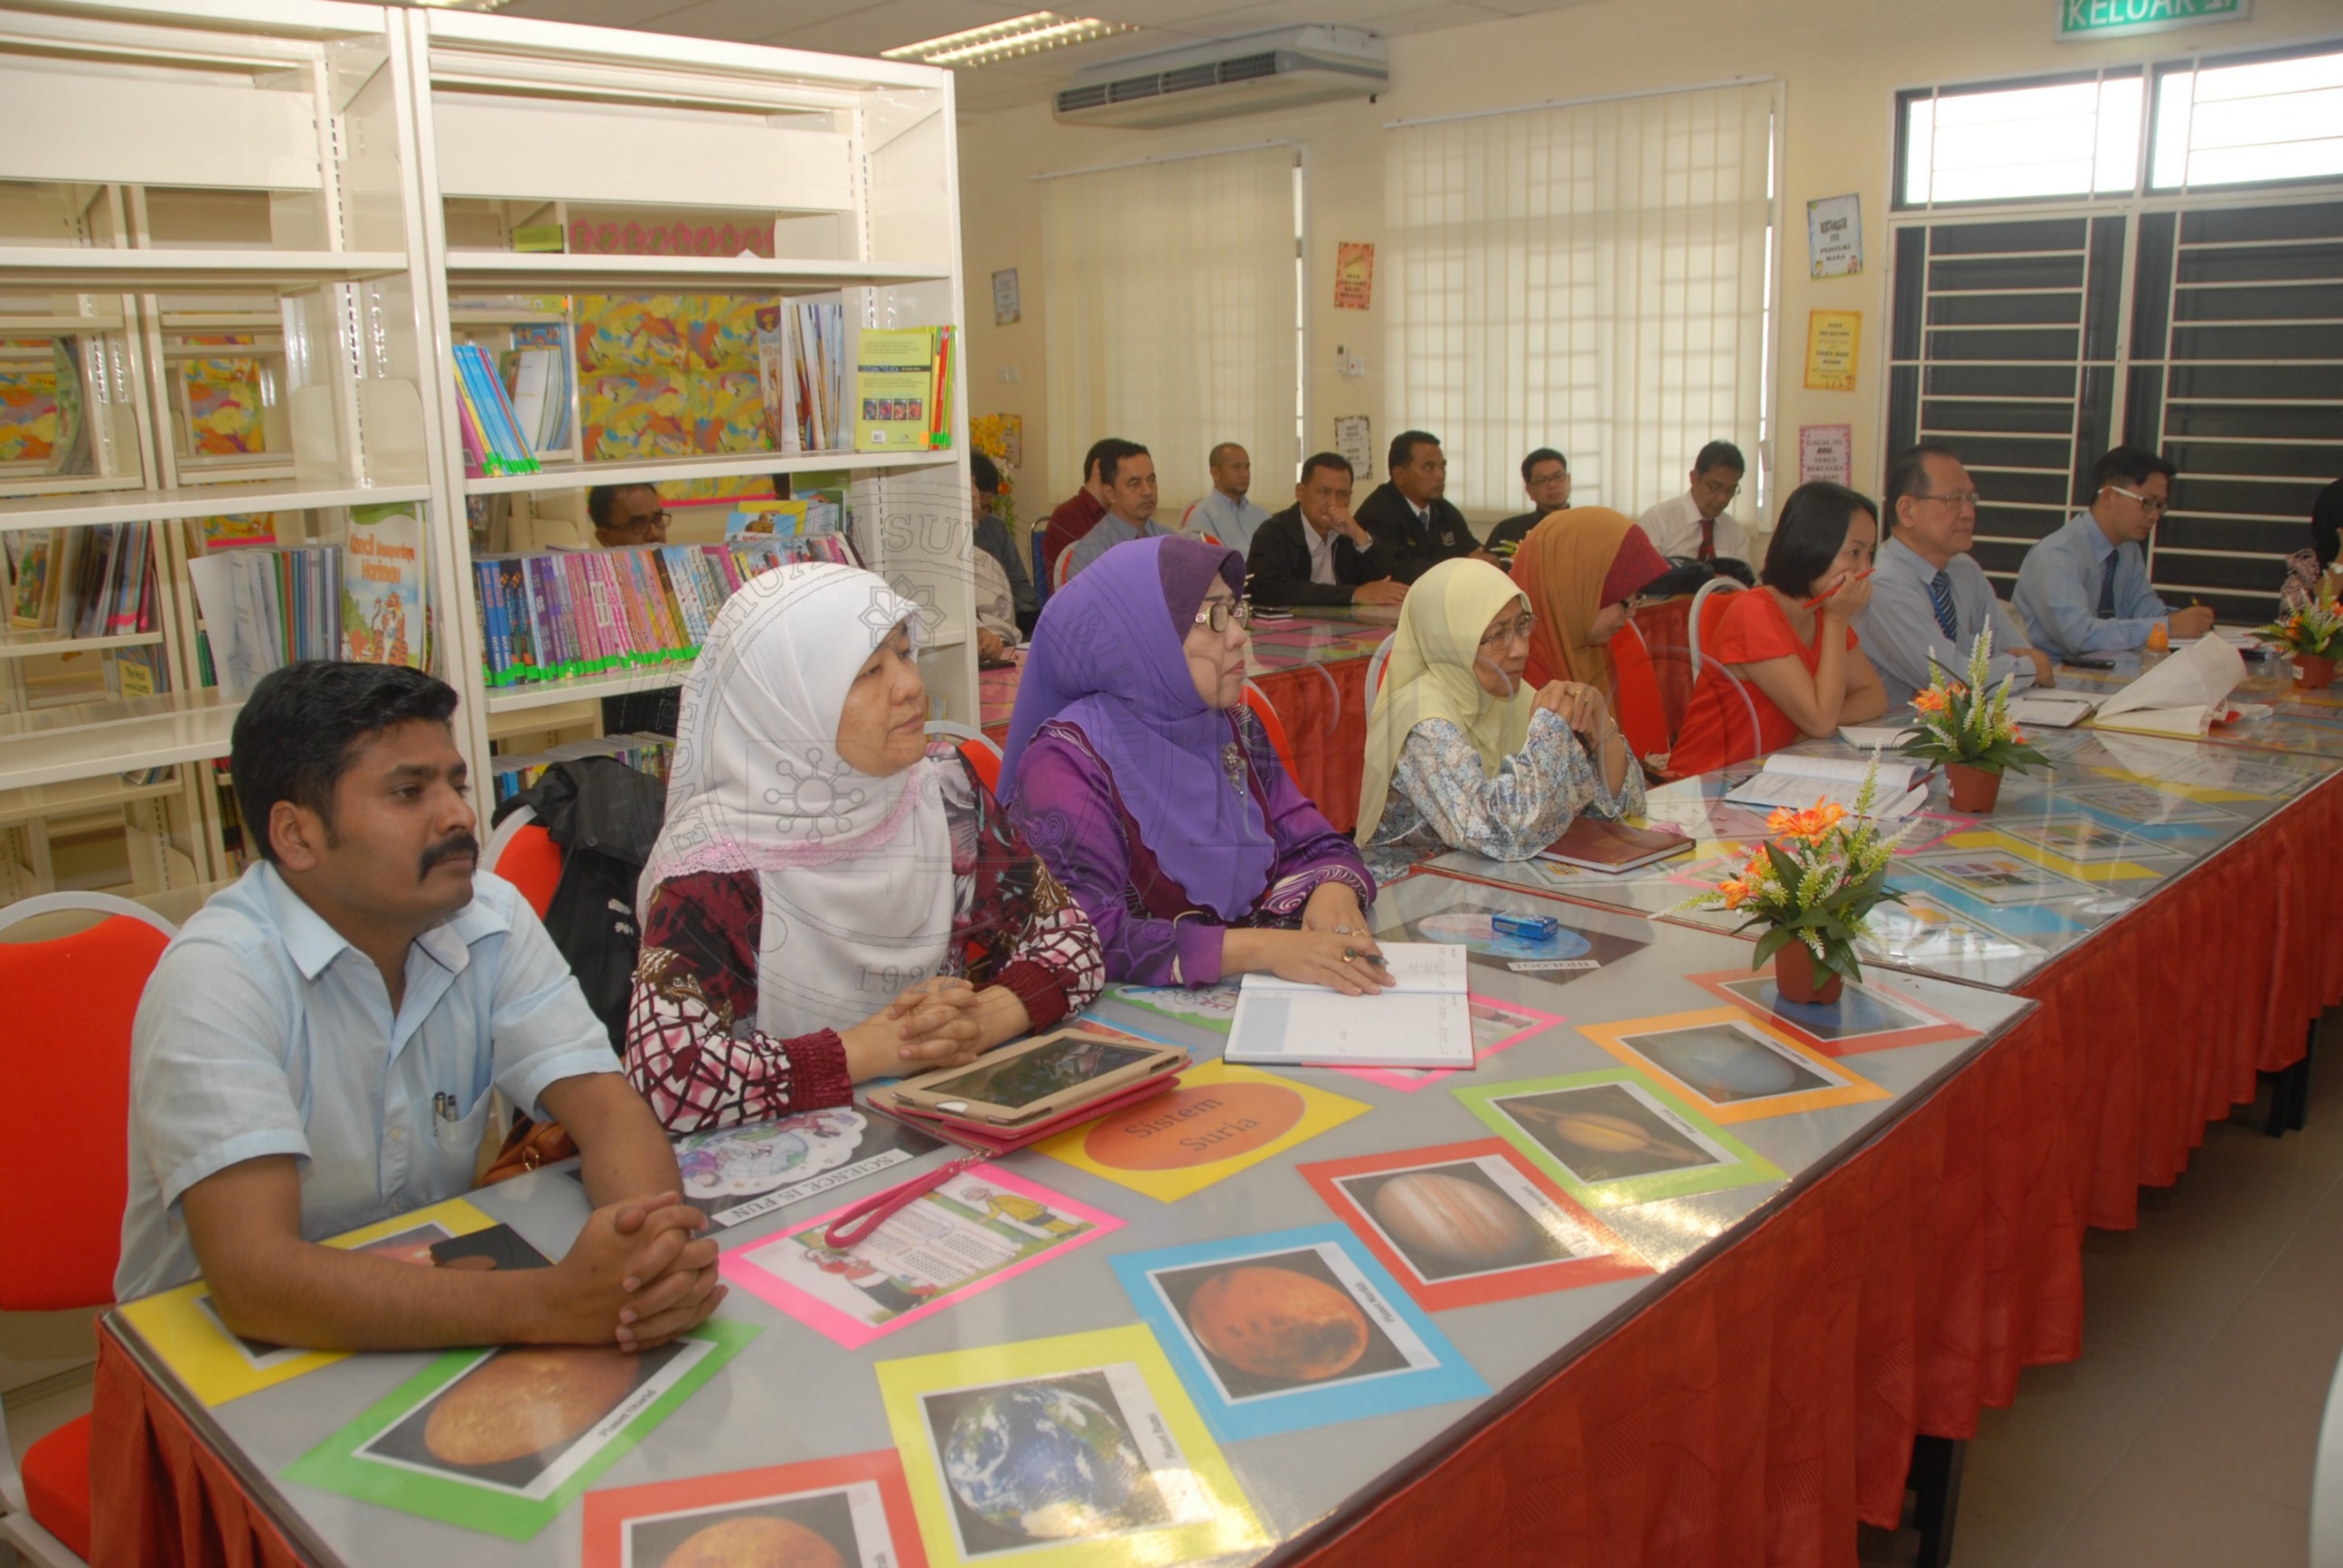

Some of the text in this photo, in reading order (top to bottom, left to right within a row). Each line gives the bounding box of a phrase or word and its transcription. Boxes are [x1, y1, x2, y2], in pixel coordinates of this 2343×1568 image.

[1124, 1097, 1225, 1139] Sistem
[1180, 1116, 1261, 1152] Suria
[734, 1154, 894, 1220] SCIENCE IS FUN
[597, 1412, 630, 1437] Planet
